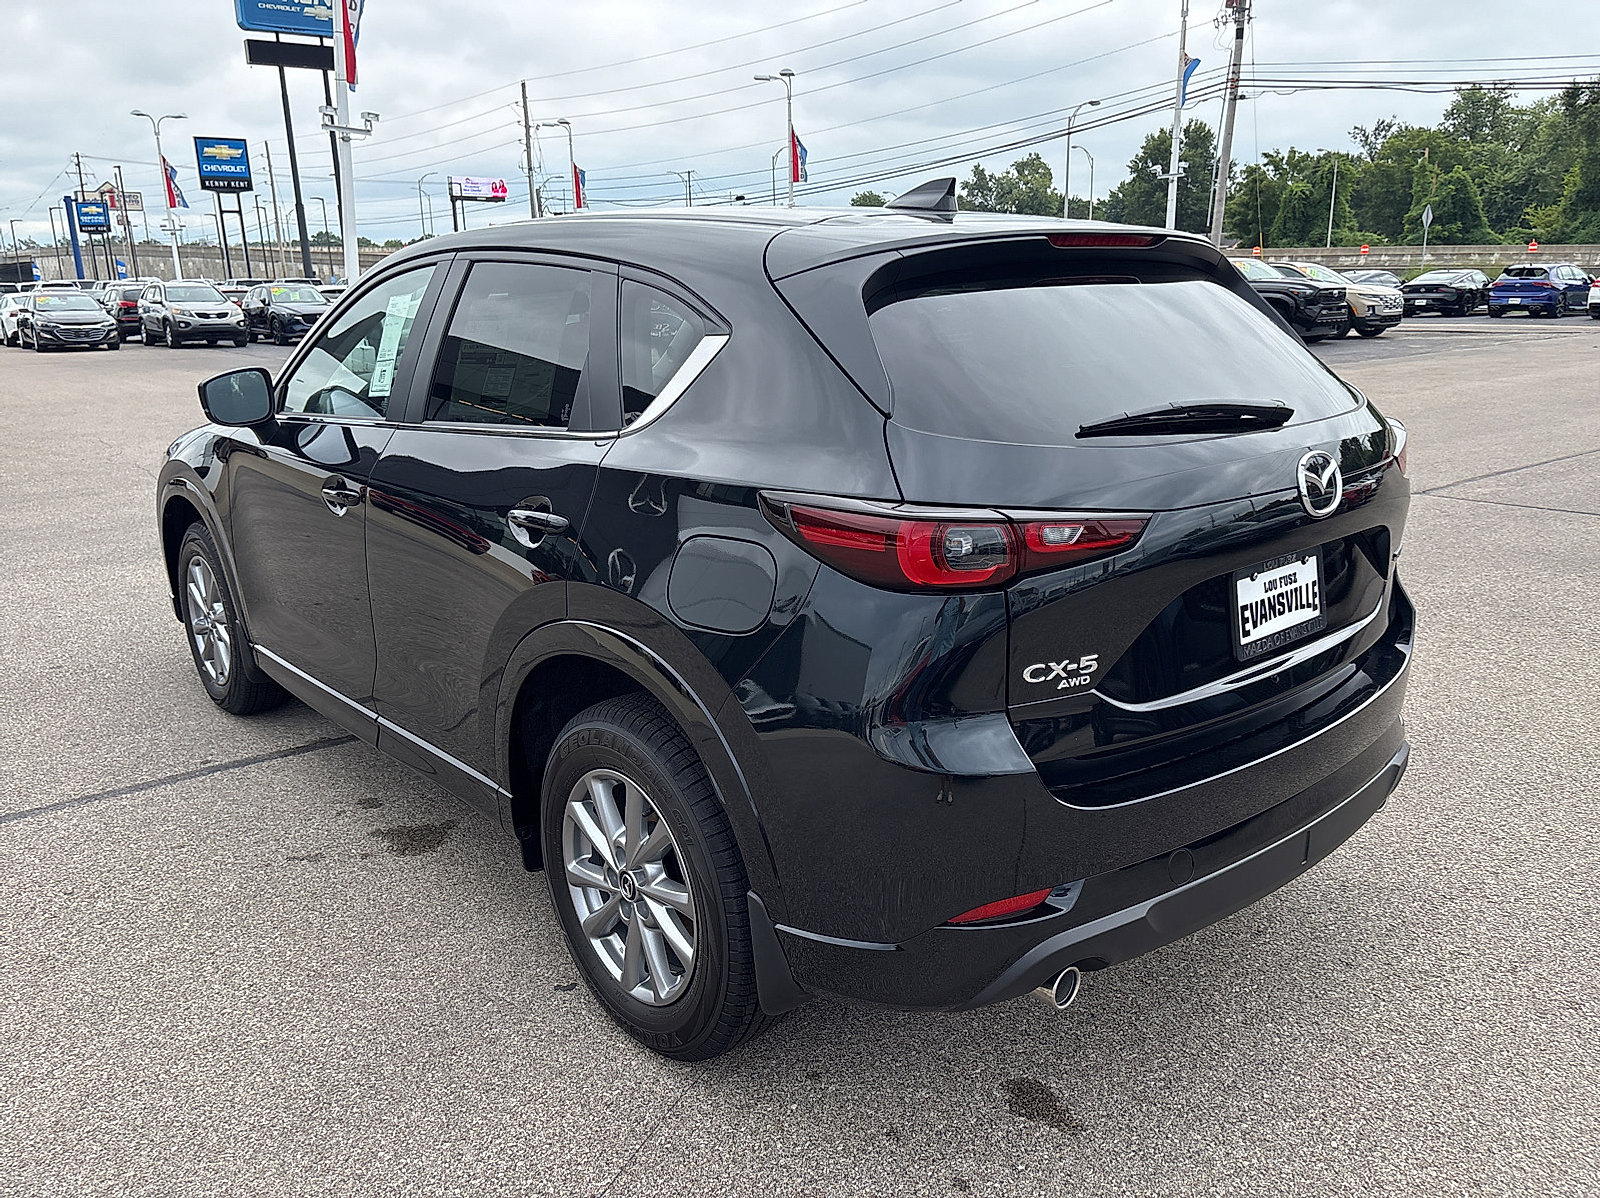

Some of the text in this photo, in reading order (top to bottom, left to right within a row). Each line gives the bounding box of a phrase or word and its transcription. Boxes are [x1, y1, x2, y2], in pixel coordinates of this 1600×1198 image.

[258, 3, 300, 12] CHEVROLET
[203, 164, 246, 173] CHEVROLET
[1263, 572, 1298, 593] LOU FUSZ
[1240, 580, 1319, 638] EVANSVILLE
[1243, 636, 1273, 658] MAZDA
[1022, 654, 1099, 683] CX-5
[1057, 675, 1091, 690] AWD
